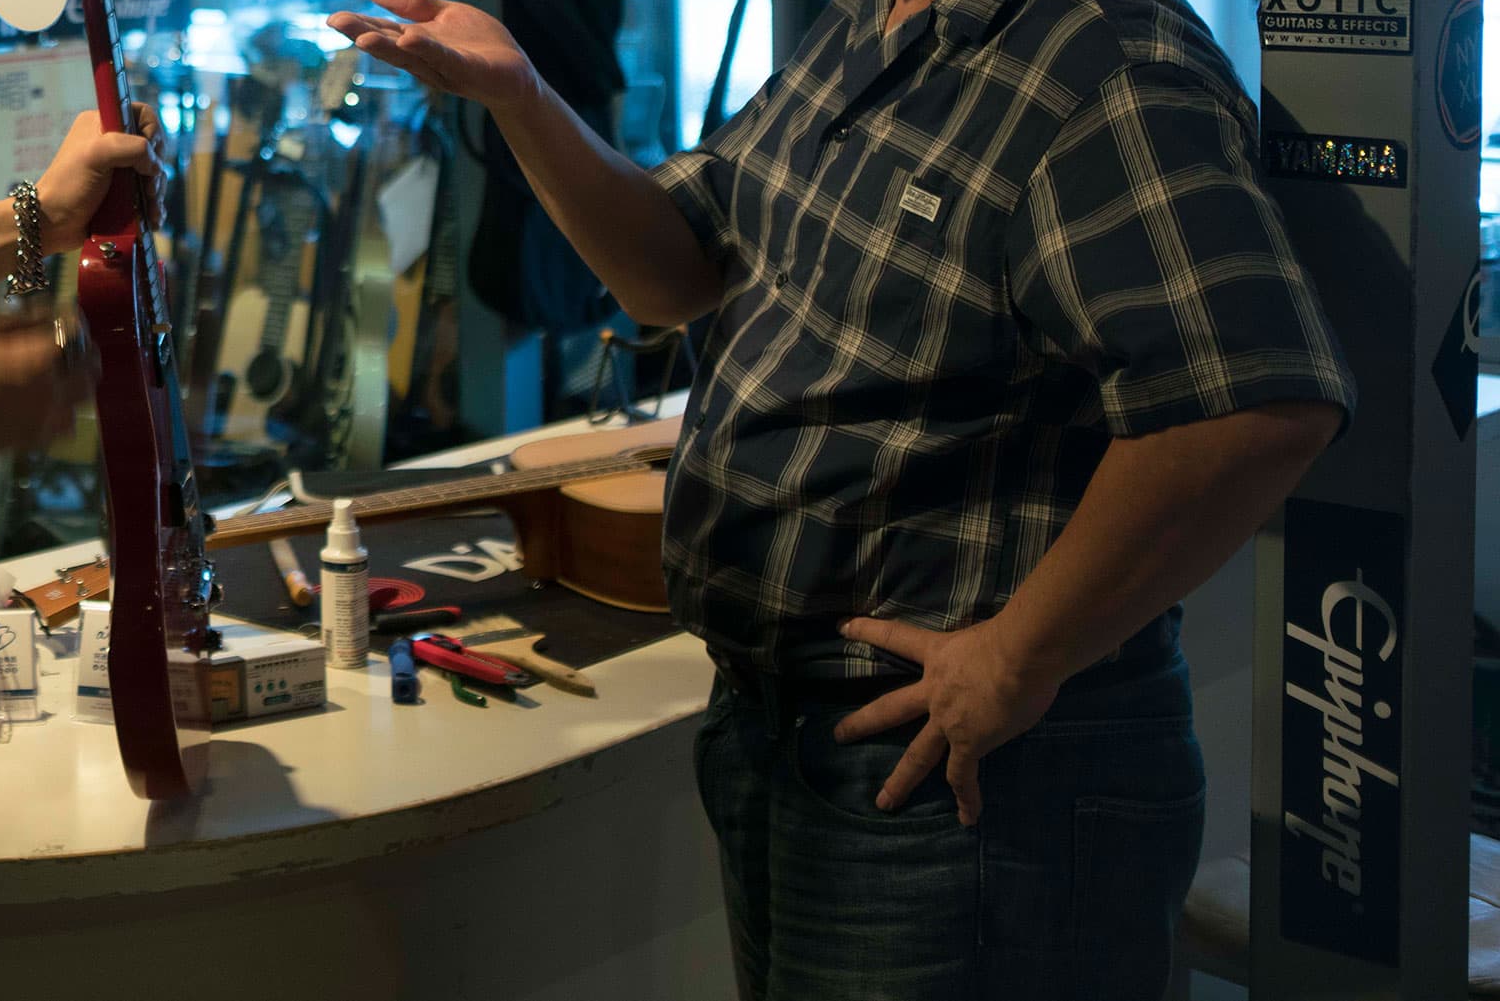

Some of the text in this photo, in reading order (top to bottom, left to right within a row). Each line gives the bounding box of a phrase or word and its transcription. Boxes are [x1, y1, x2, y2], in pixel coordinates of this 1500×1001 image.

[1264, 16, 1399, 33] GUITARS & EFFECTS
[1265, 34, 1398, 47] www.xotic.us
[1276, 140, 1400, 179] YAMAHA
[1285, 567, 1399, 898] Epiphone
